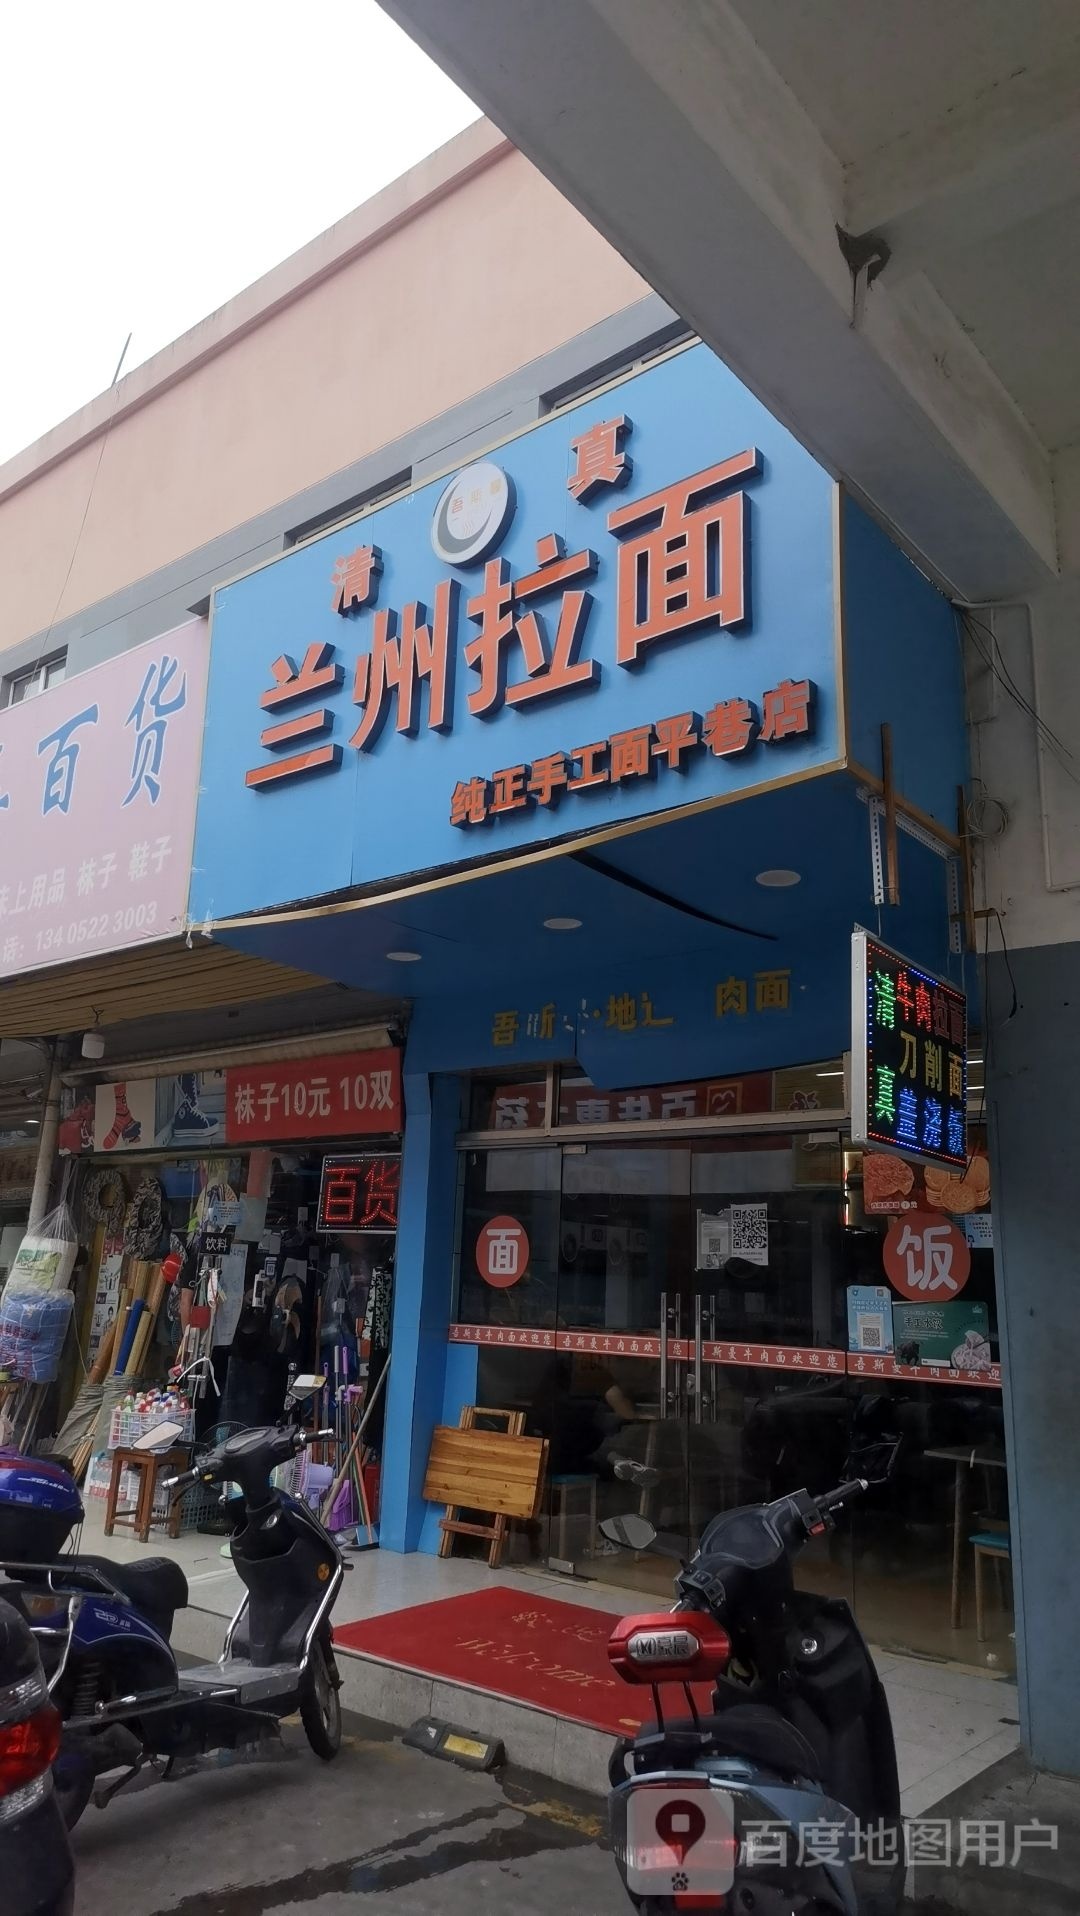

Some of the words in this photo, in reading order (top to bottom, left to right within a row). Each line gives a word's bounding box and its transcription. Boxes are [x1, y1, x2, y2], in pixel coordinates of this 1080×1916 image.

[331, 545, 382, 614] 清
[567, 414, 634, 502] 真
[245, 446, 764, 791] 兰州拉面
[0, 655, 187, 816] 百货
[450, 678, 817, 828] 纯正手工面平巷店
[77, 852, 118, 897] 袜子
[127, 835, 172, 881] 鞋子
[35, 924, 65, 953] 134
[67, 914, 109, 945] 0522
[112, 901, 158, 932] 3003
[715, 969, 792, 1019] 肉面
[899, 1030, 963, 1100] 刀削面
[234, 1077, 331, 1125] 袜子10元
[339, 1070, 395, 1112] 10双
[325, 1160, 400, 1226] 百货
[205, 1236, 228, 1252] 饮料
[486, 1227, 522, 1275] 面
[896, 1225, 958, 1291] 饭
[562, 1337, 683, 1356] 吾斯曼牛肉面欢您
[702, 1345, 839, 1369] 斯曼牛肉面欢迎您
